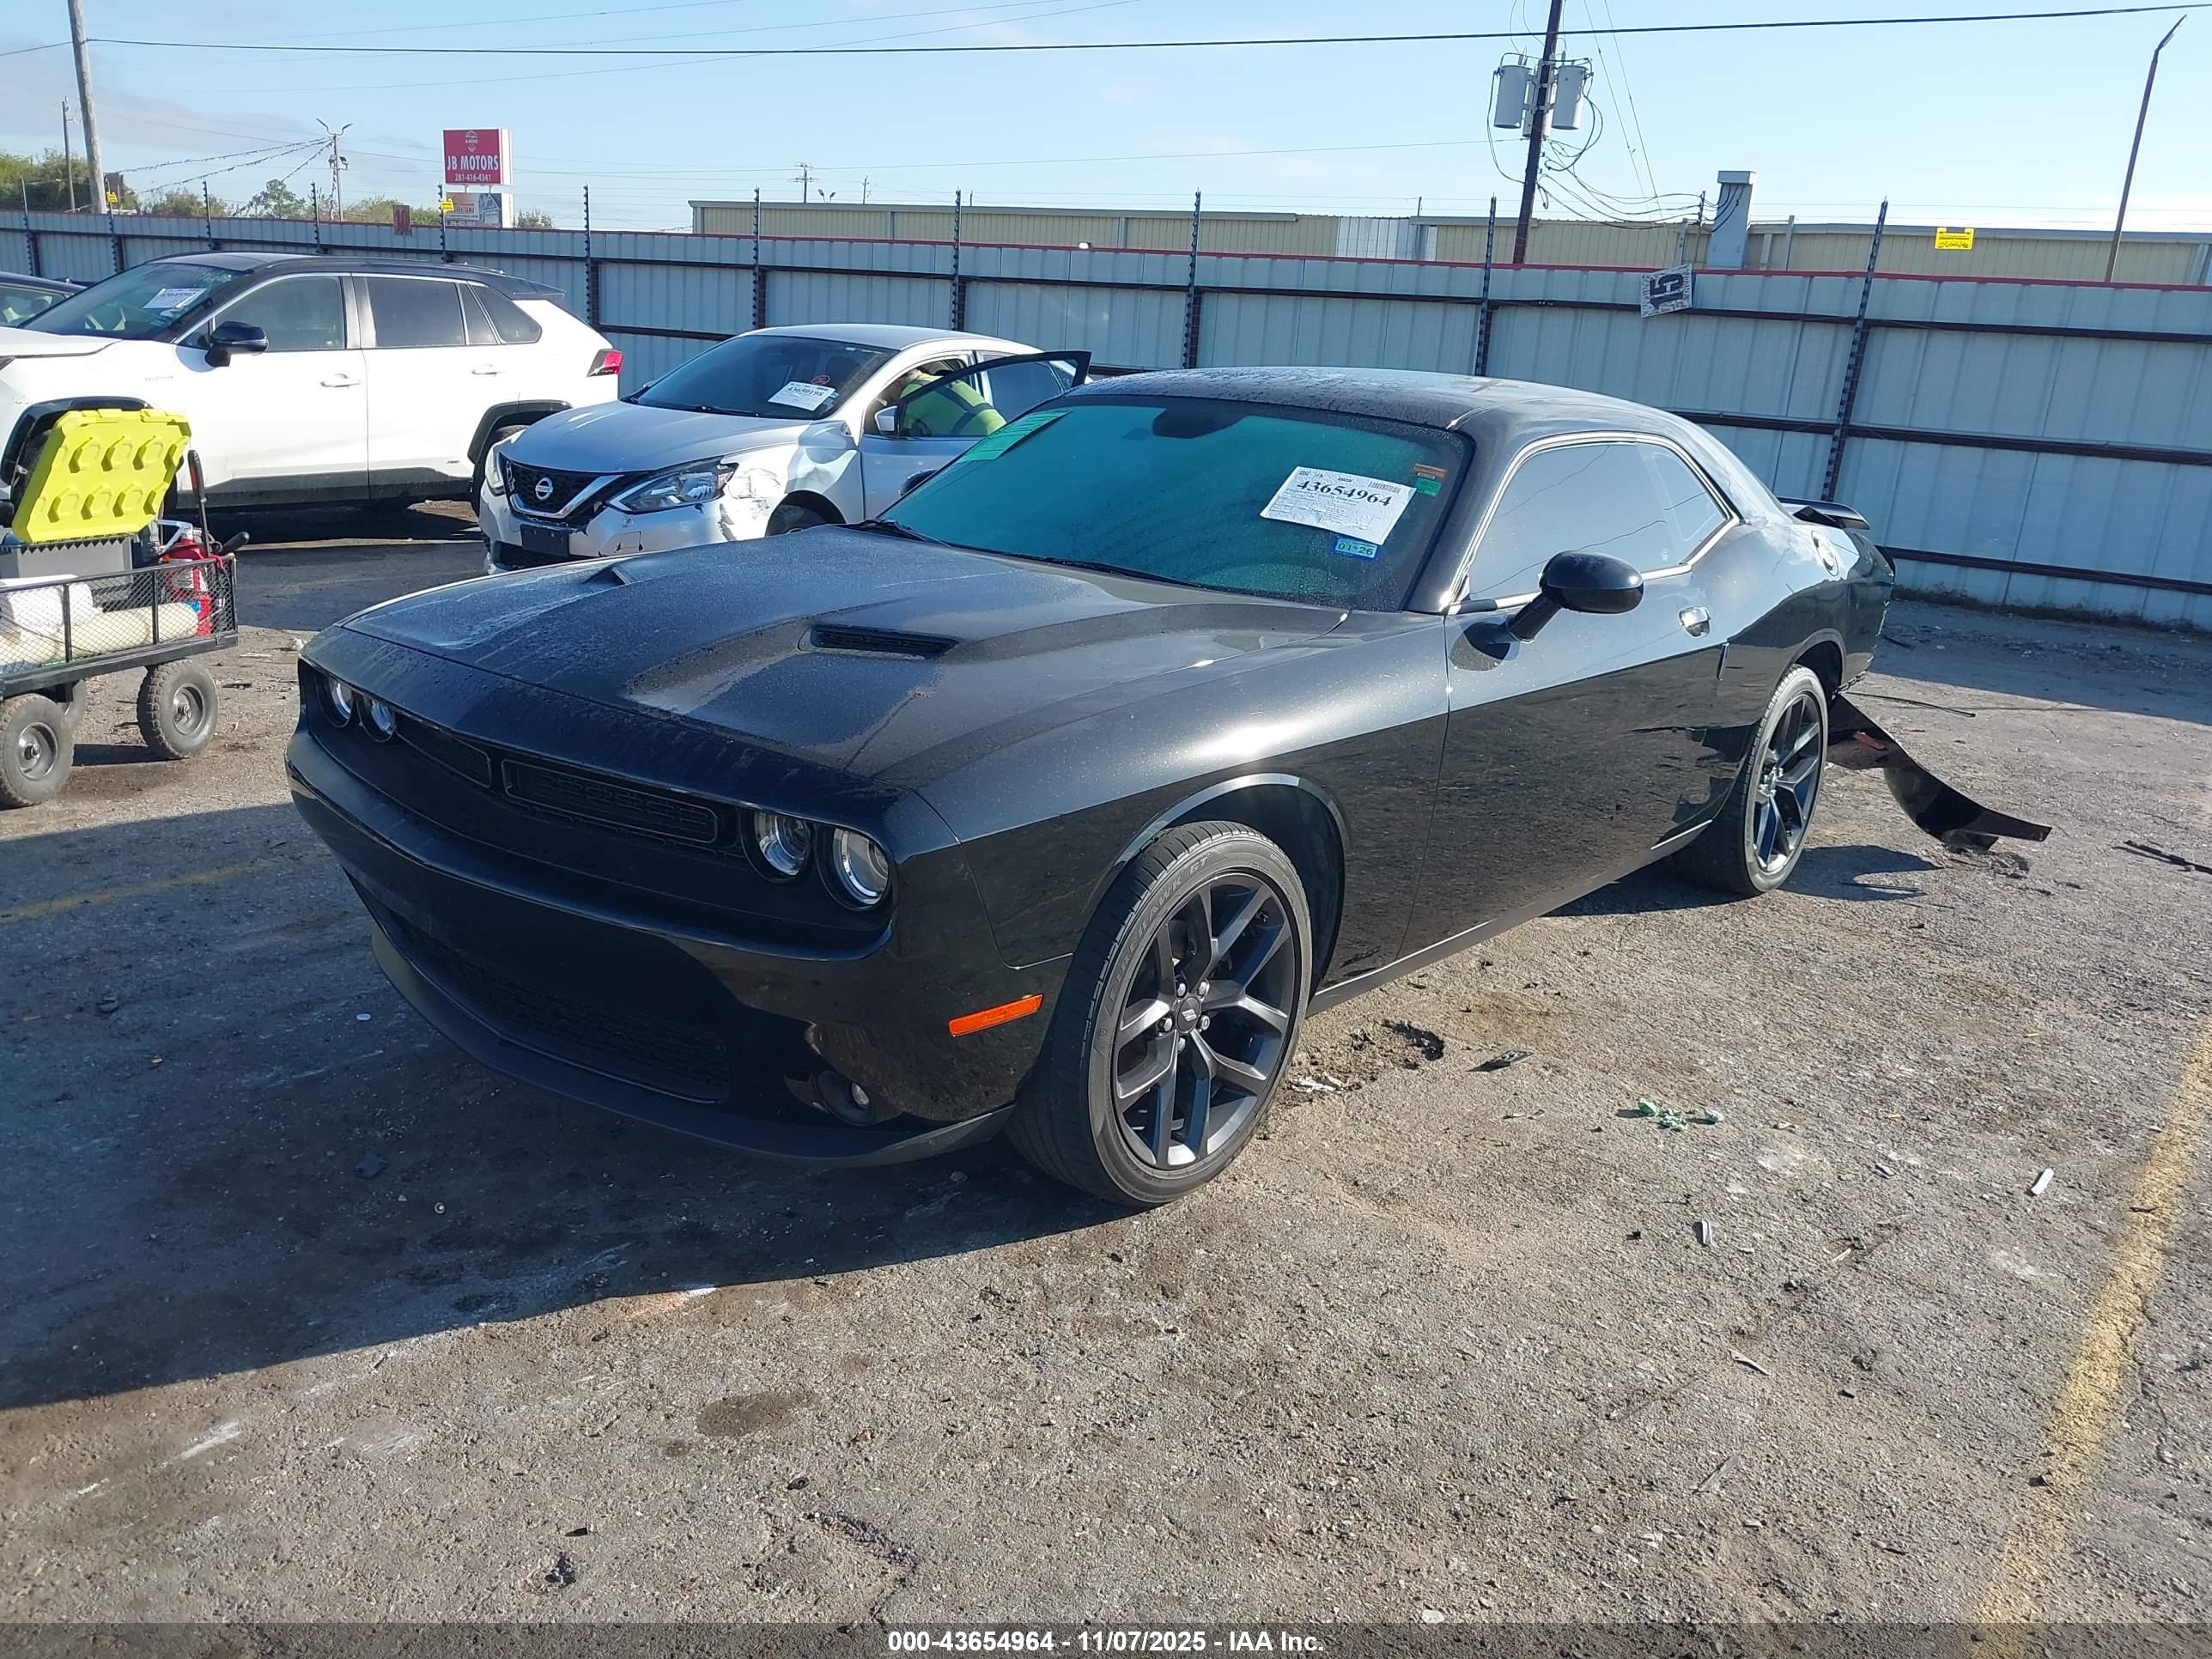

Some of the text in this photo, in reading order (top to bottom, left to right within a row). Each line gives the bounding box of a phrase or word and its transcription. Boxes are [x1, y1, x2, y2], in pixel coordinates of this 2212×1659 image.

[447, 155, 499, 171] JB MOTORS
[1649, 273, 1684, 311] 15
[1296, 479, 1394, 507] 43654964
[1338, 543, 1374, 556] 01 26
